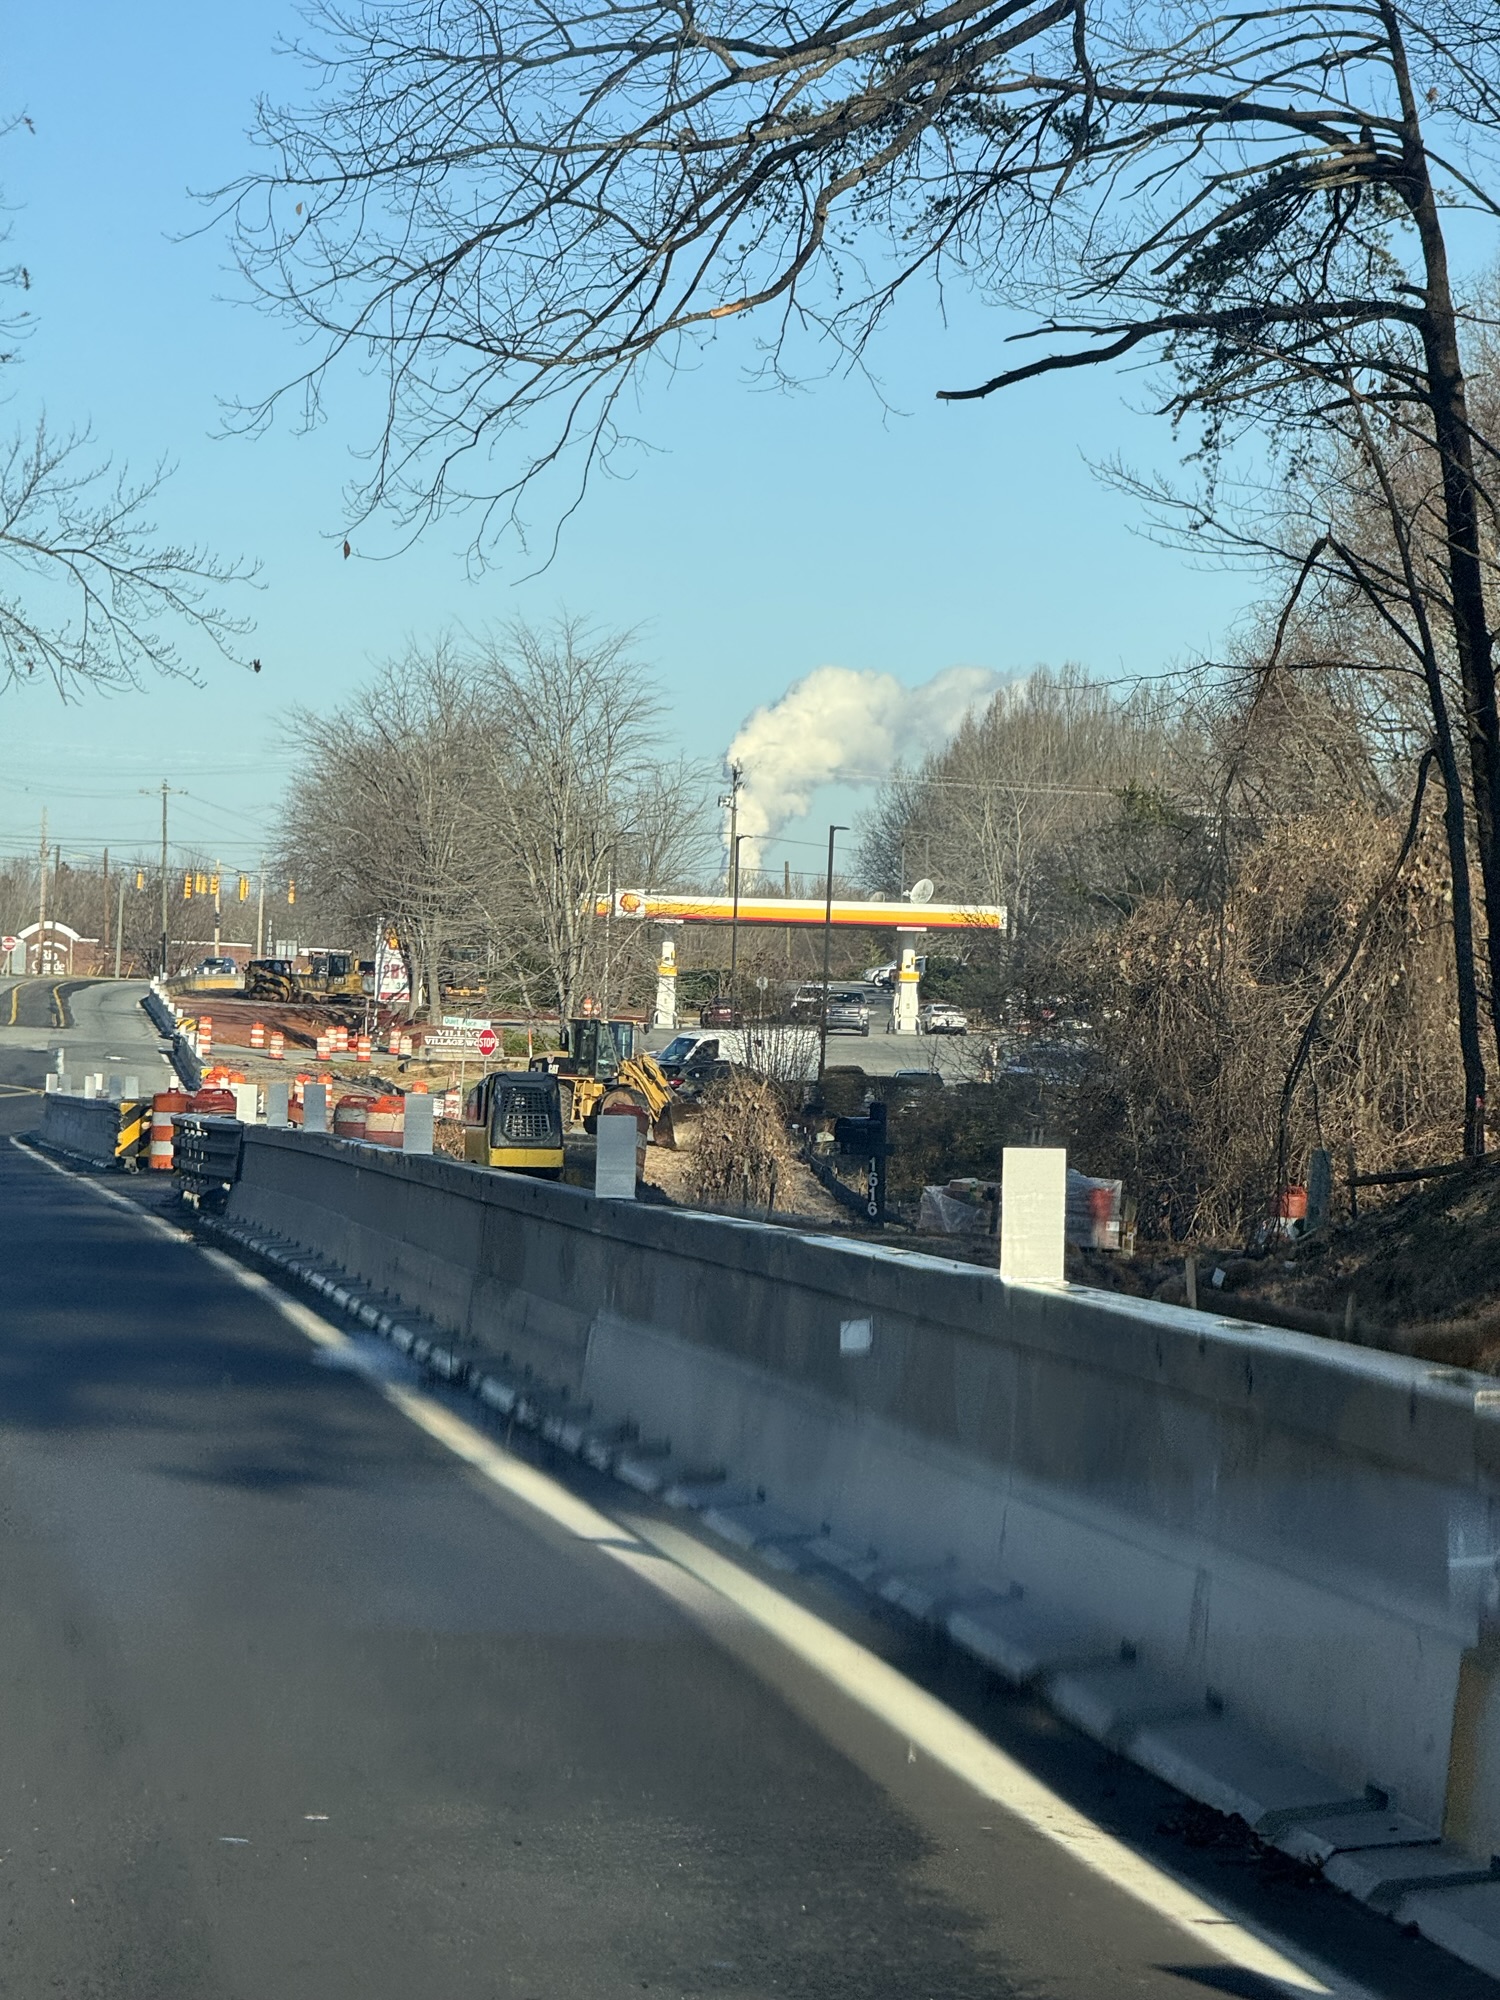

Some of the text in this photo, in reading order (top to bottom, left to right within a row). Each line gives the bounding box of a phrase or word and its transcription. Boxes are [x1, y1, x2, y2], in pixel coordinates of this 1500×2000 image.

[436, 1029, 480, 1037] VILLAG
[480, 1038, 496, 1047] STOP
[548, 1064, 559, 1074] CAT
[868, 1156, 879, 1217] 1616
